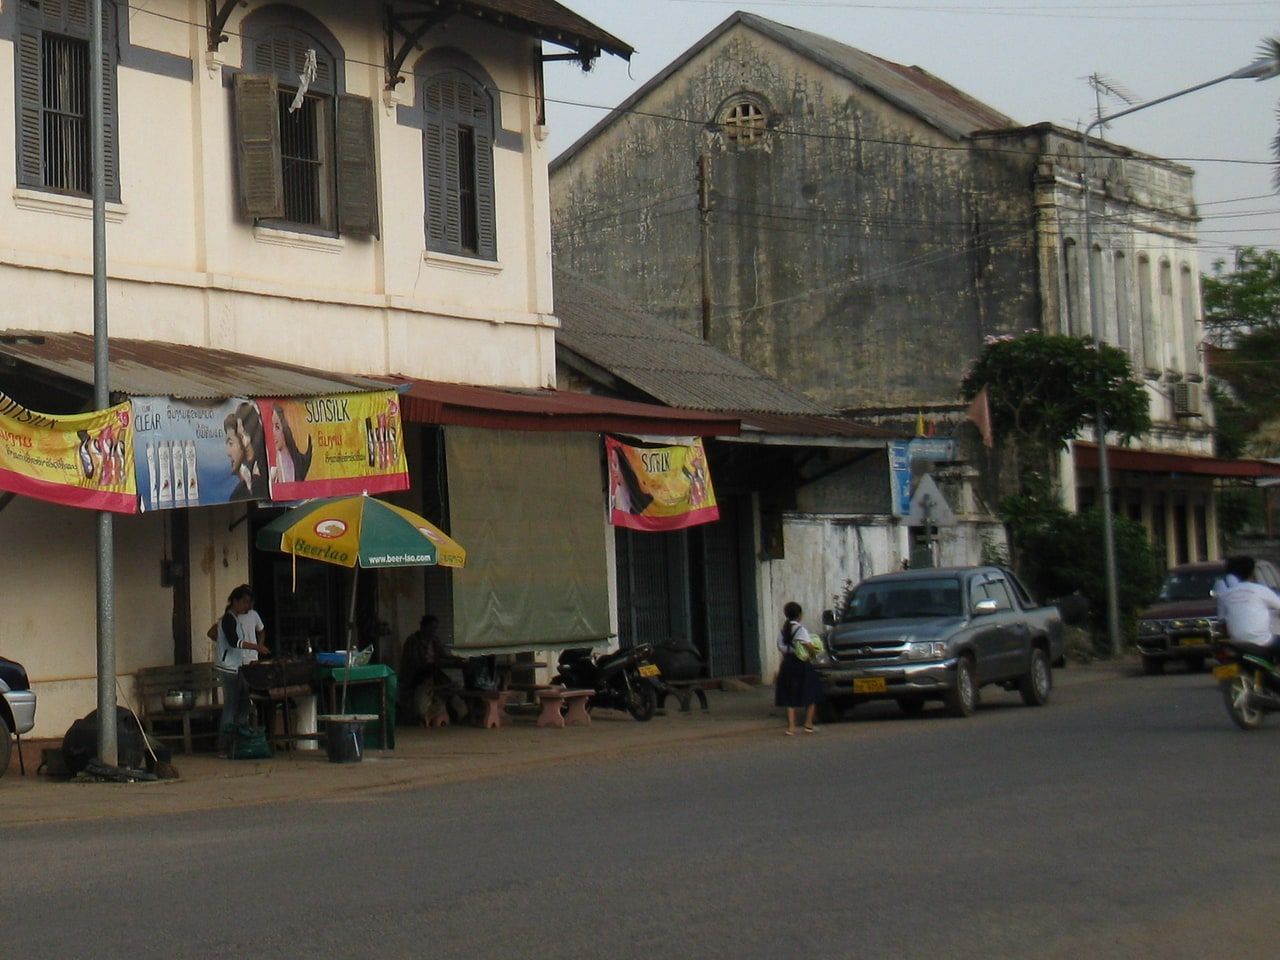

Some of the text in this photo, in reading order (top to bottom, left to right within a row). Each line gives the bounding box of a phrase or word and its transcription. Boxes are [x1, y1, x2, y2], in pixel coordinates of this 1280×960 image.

[134, 413, 162, 434] CLEAR
[294, 538, 349, 563] Beerlao
[368, 553, 432, 565] www.beer-lao.com
